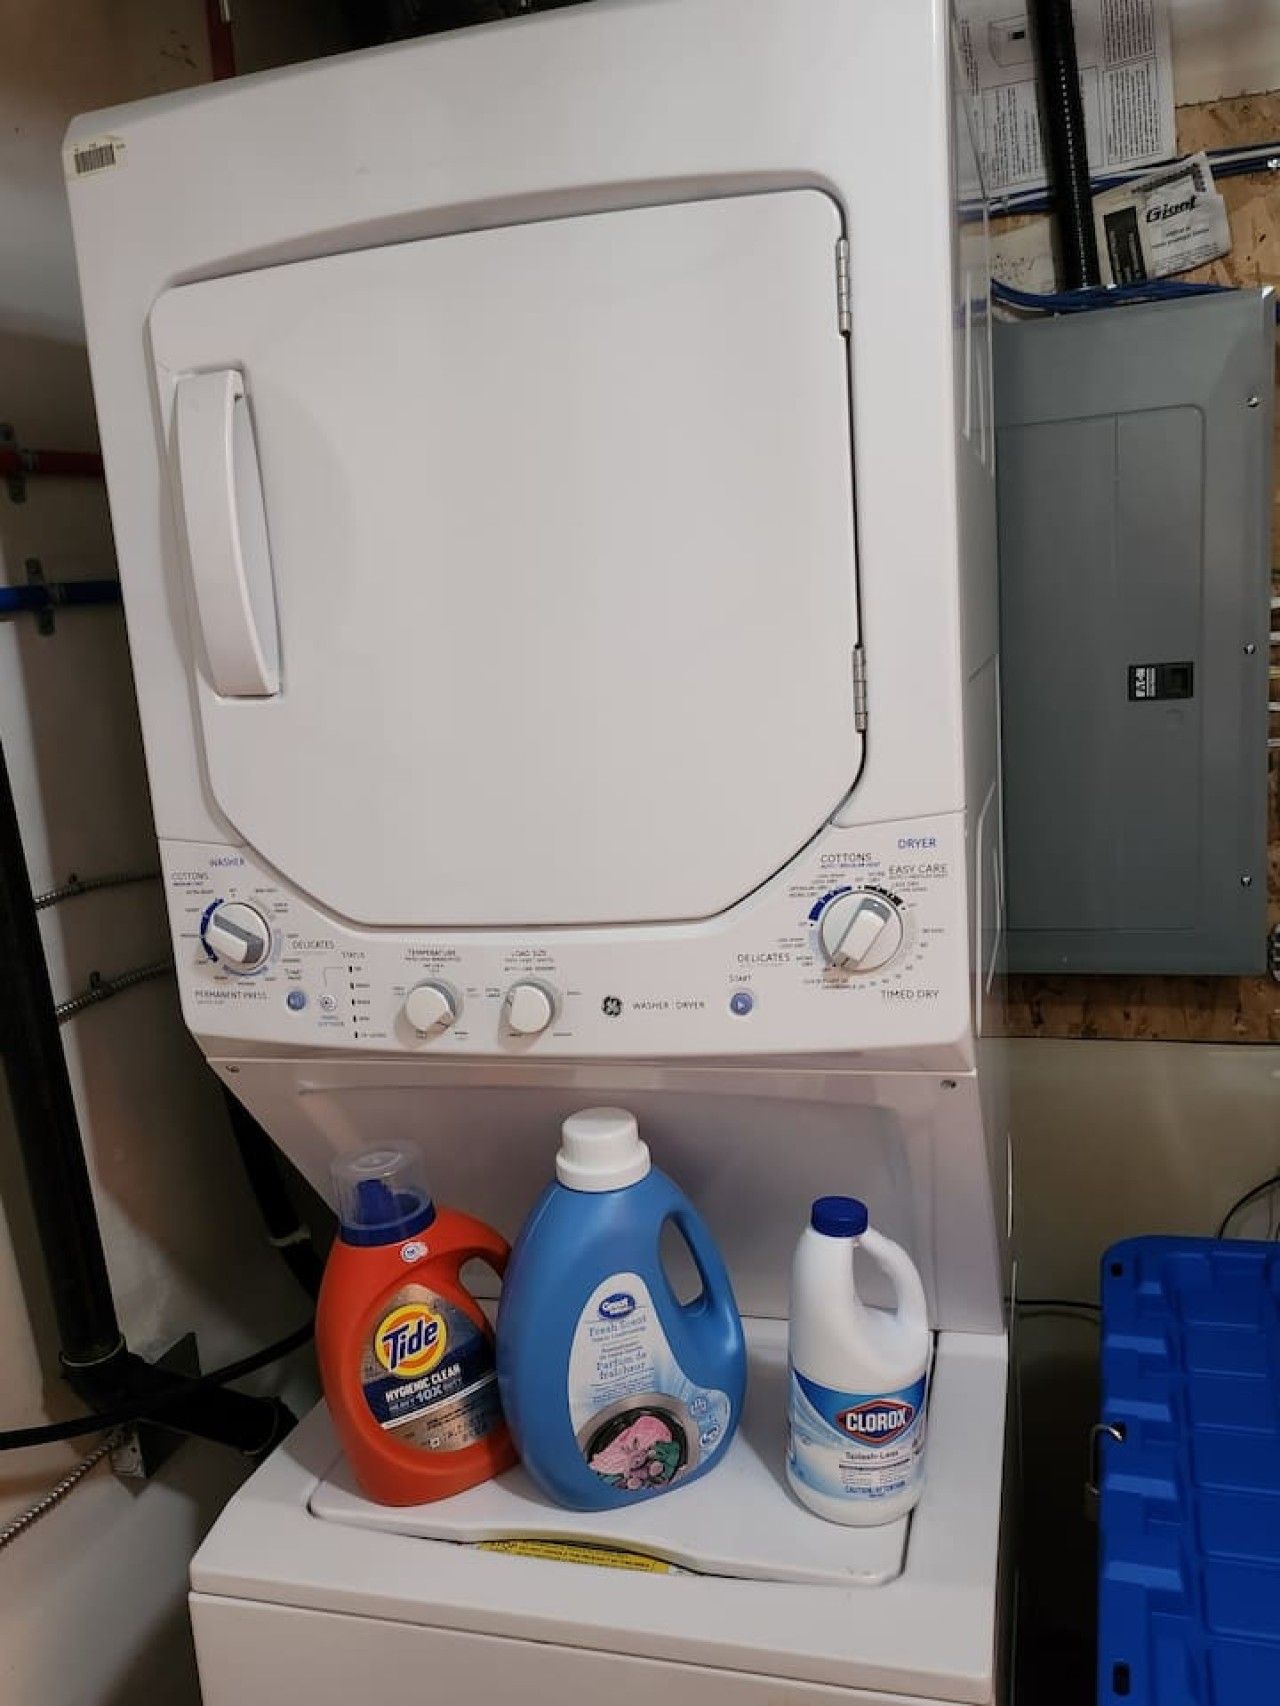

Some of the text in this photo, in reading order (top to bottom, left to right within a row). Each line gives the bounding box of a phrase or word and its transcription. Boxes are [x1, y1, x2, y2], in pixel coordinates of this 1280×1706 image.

[897, 837, 937, 849] DRYER
[820, 852, 873, 864] COTTONS
[888, 863, 917, 875] EASY
[917, 862, 949, 874] CARE
[291, 939, 335, 950] DELICATES
[736, 952, 791, 963] DELICATES
[880, 989, 940, 1000] TIMED DRY
[383, 1315, 439, 1371] Tide
[845, 1407, 906, 1433] CLOROX
